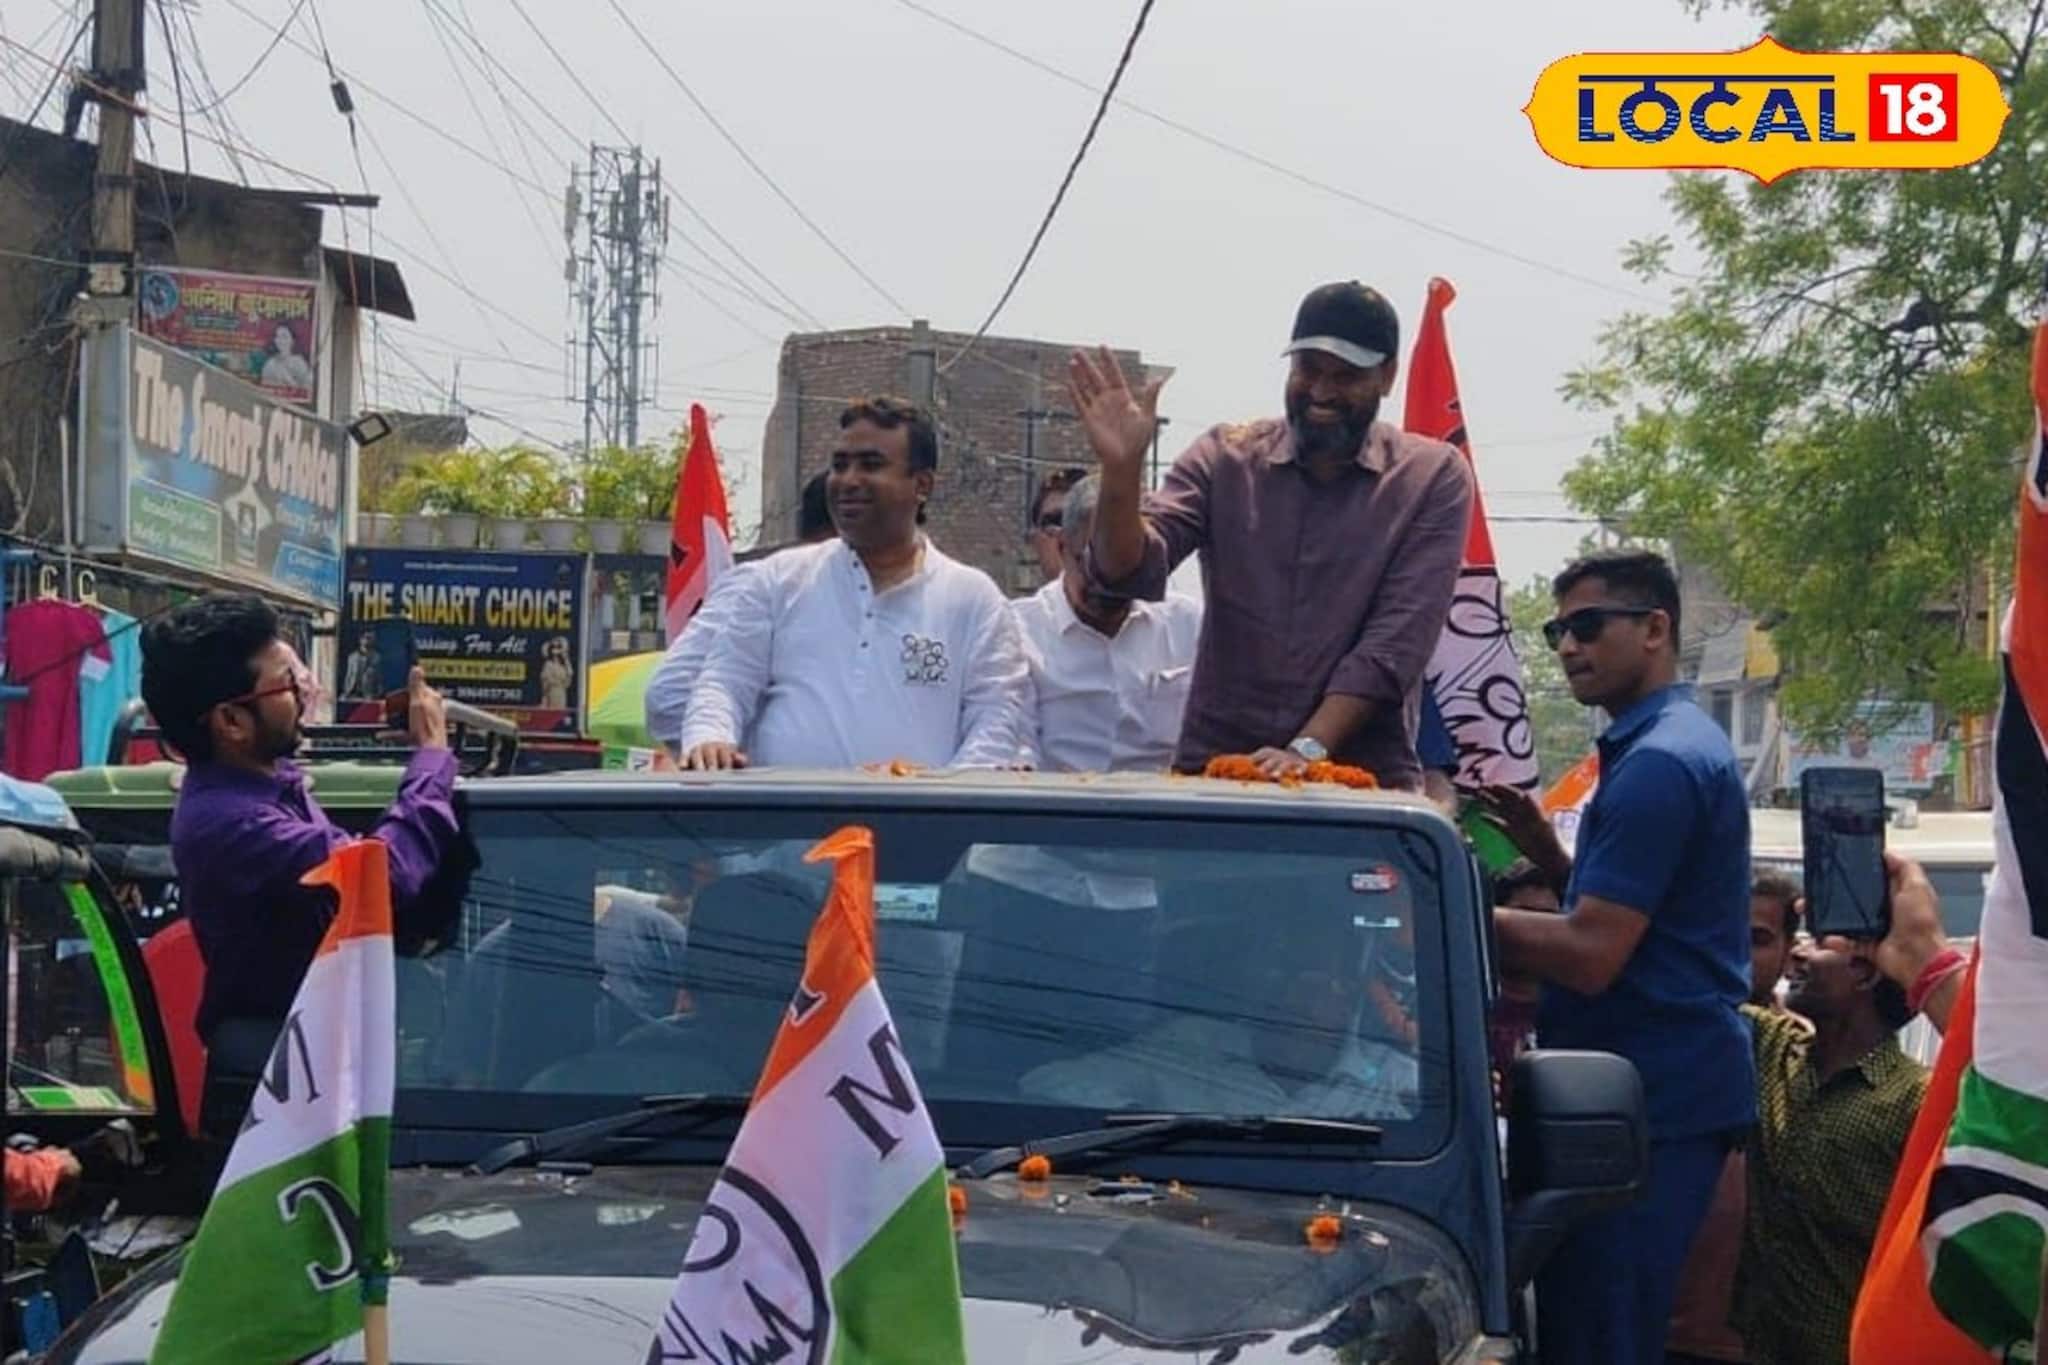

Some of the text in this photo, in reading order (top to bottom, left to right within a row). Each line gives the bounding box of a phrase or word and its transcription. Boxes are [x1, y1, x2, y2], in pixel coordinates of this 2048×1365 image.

[134, 344, 184, 455] The
[189, 371, 263, 489] Smart
[348, 581, 394, 621] THE
[401, 583, 480, 627] SMART
[485, 588, 572, 630] CHOICE
